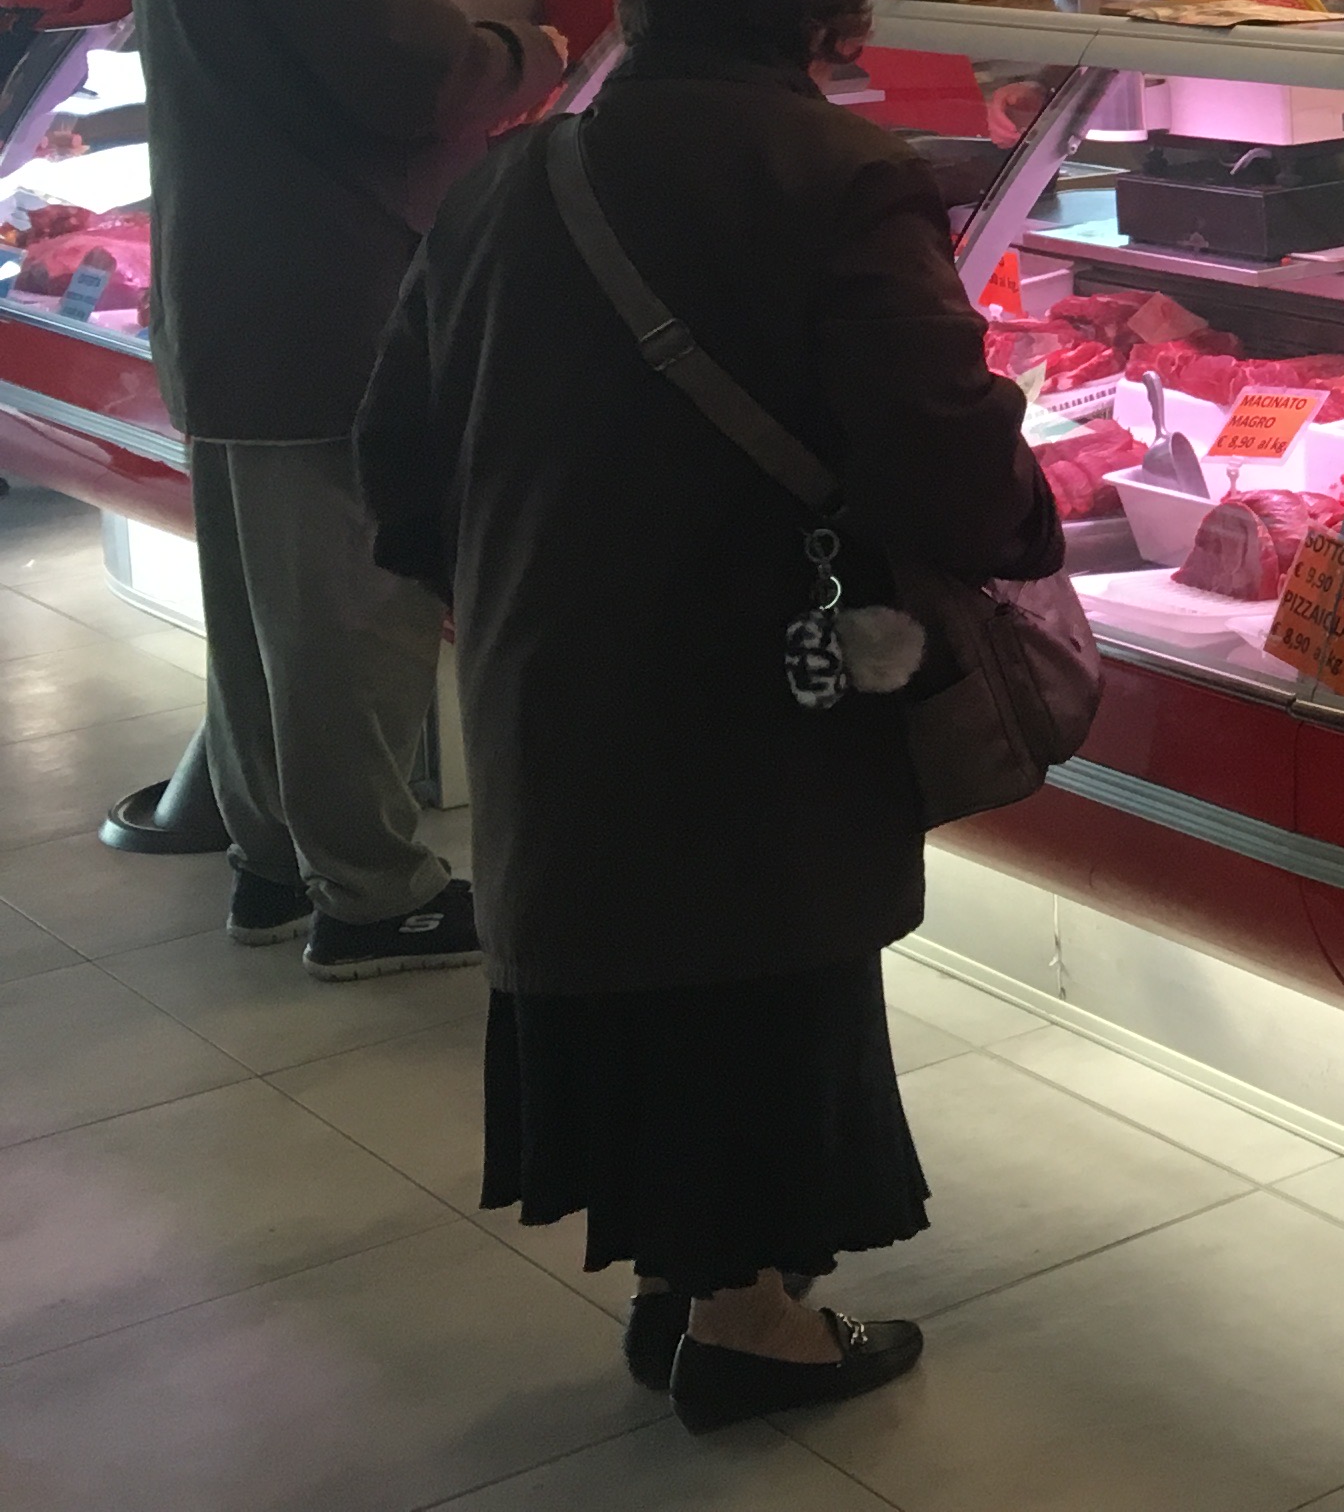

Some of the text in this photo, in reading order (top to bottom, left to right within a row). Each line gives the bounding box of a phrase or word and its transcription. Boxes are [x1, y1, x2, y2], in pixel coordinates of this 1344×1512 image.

[1240, 394, 1308, 410] MACINATO
[1228, 415, 1277, 429] MAGRO
[1217, 435, 1228, 447] €
[1228, 435, 1256, 450] 8,90
[1257, 437, 1272, 450] al
[1305, 566, 1333, 593] 9,90
[1282, 627, 1311, 655] 8,90
